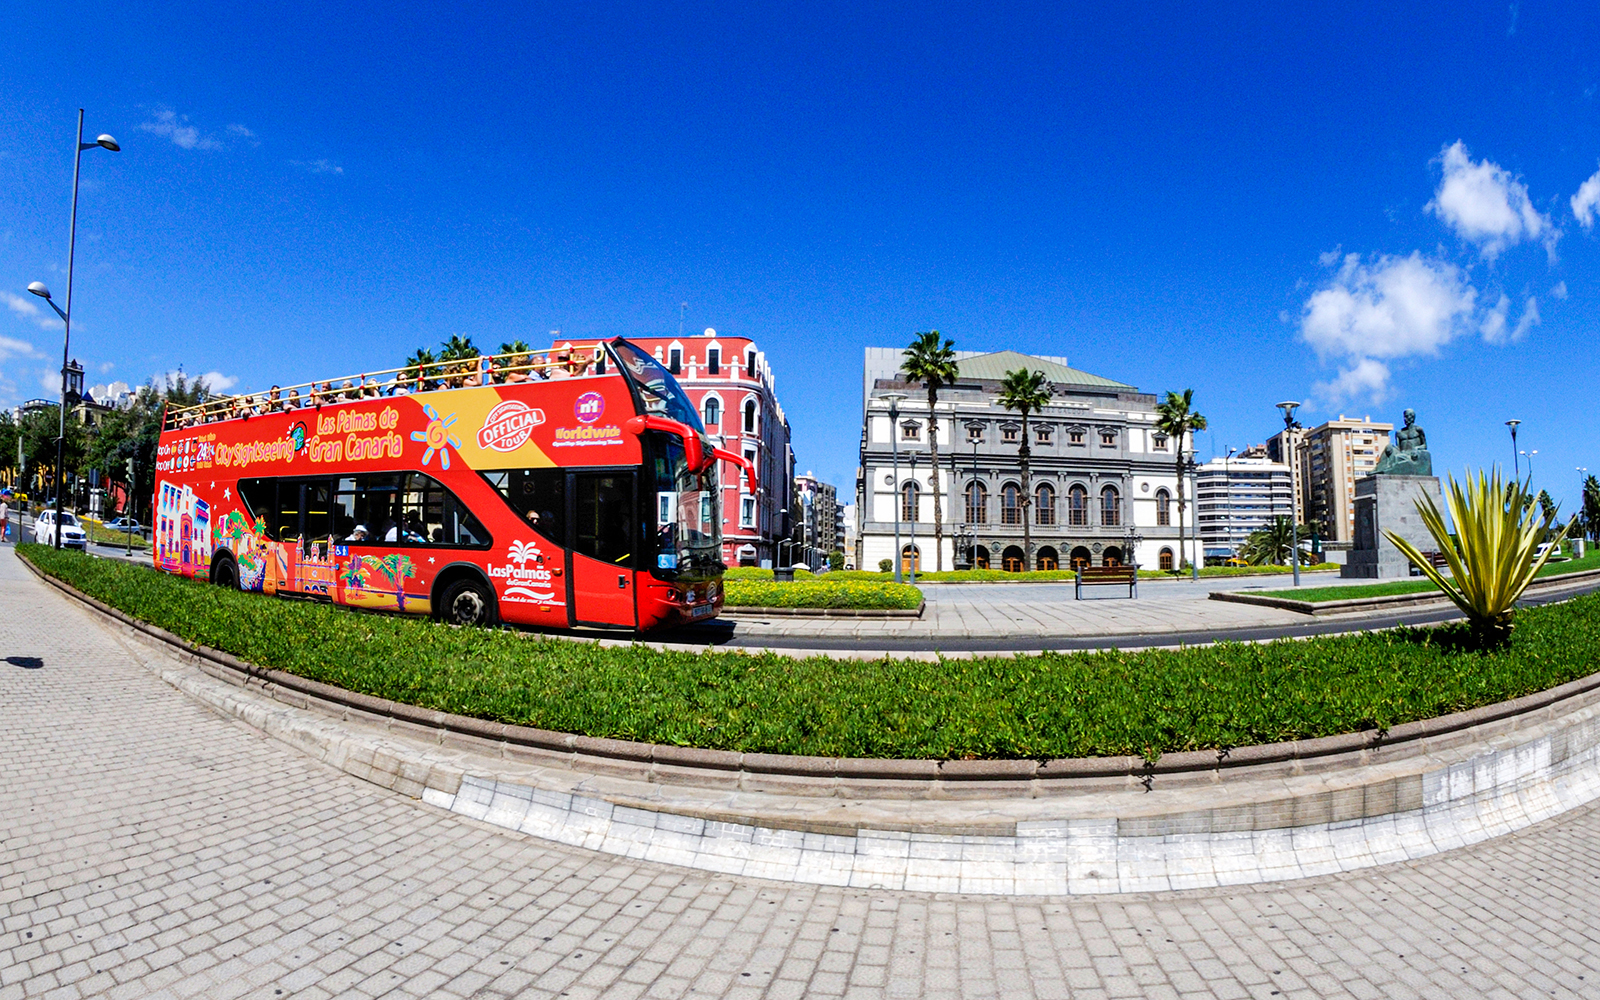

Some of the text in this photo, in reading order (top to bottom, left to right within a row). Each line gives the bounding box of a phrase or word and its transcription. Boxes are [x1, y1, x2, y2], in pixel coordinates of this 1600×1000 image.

[316, 405, 399, 435] Las Palmas de
[483, 411, 541, 443] OFFICIAL
[555, 425, 621, 440] Worldwide
[309, 431, 403, 463] Gran Canaria
[501, 430, 527, 447] TOUR
